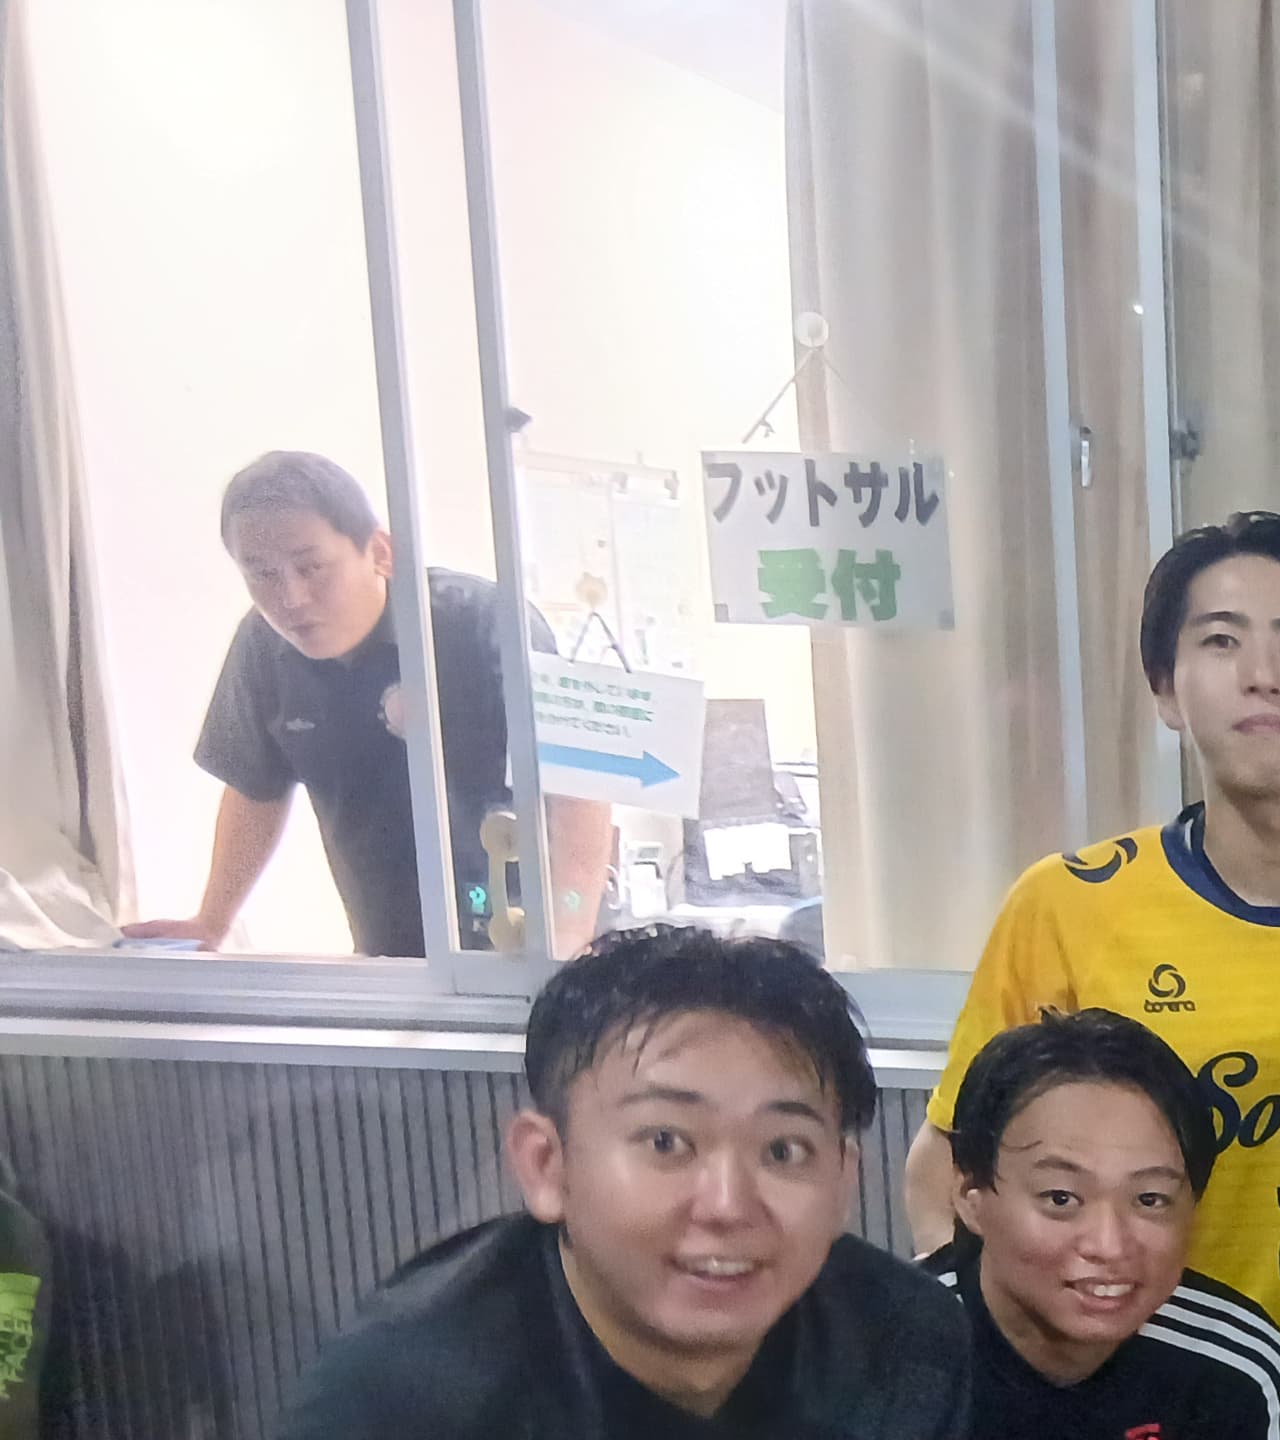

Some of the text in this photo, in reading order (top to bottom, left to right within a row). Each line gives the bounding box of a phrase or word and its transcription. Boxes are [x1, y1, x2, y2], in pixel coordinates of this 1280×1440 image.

[706, 459, 940, 528] フットサル
[757, 547, 901, 621] 受付
